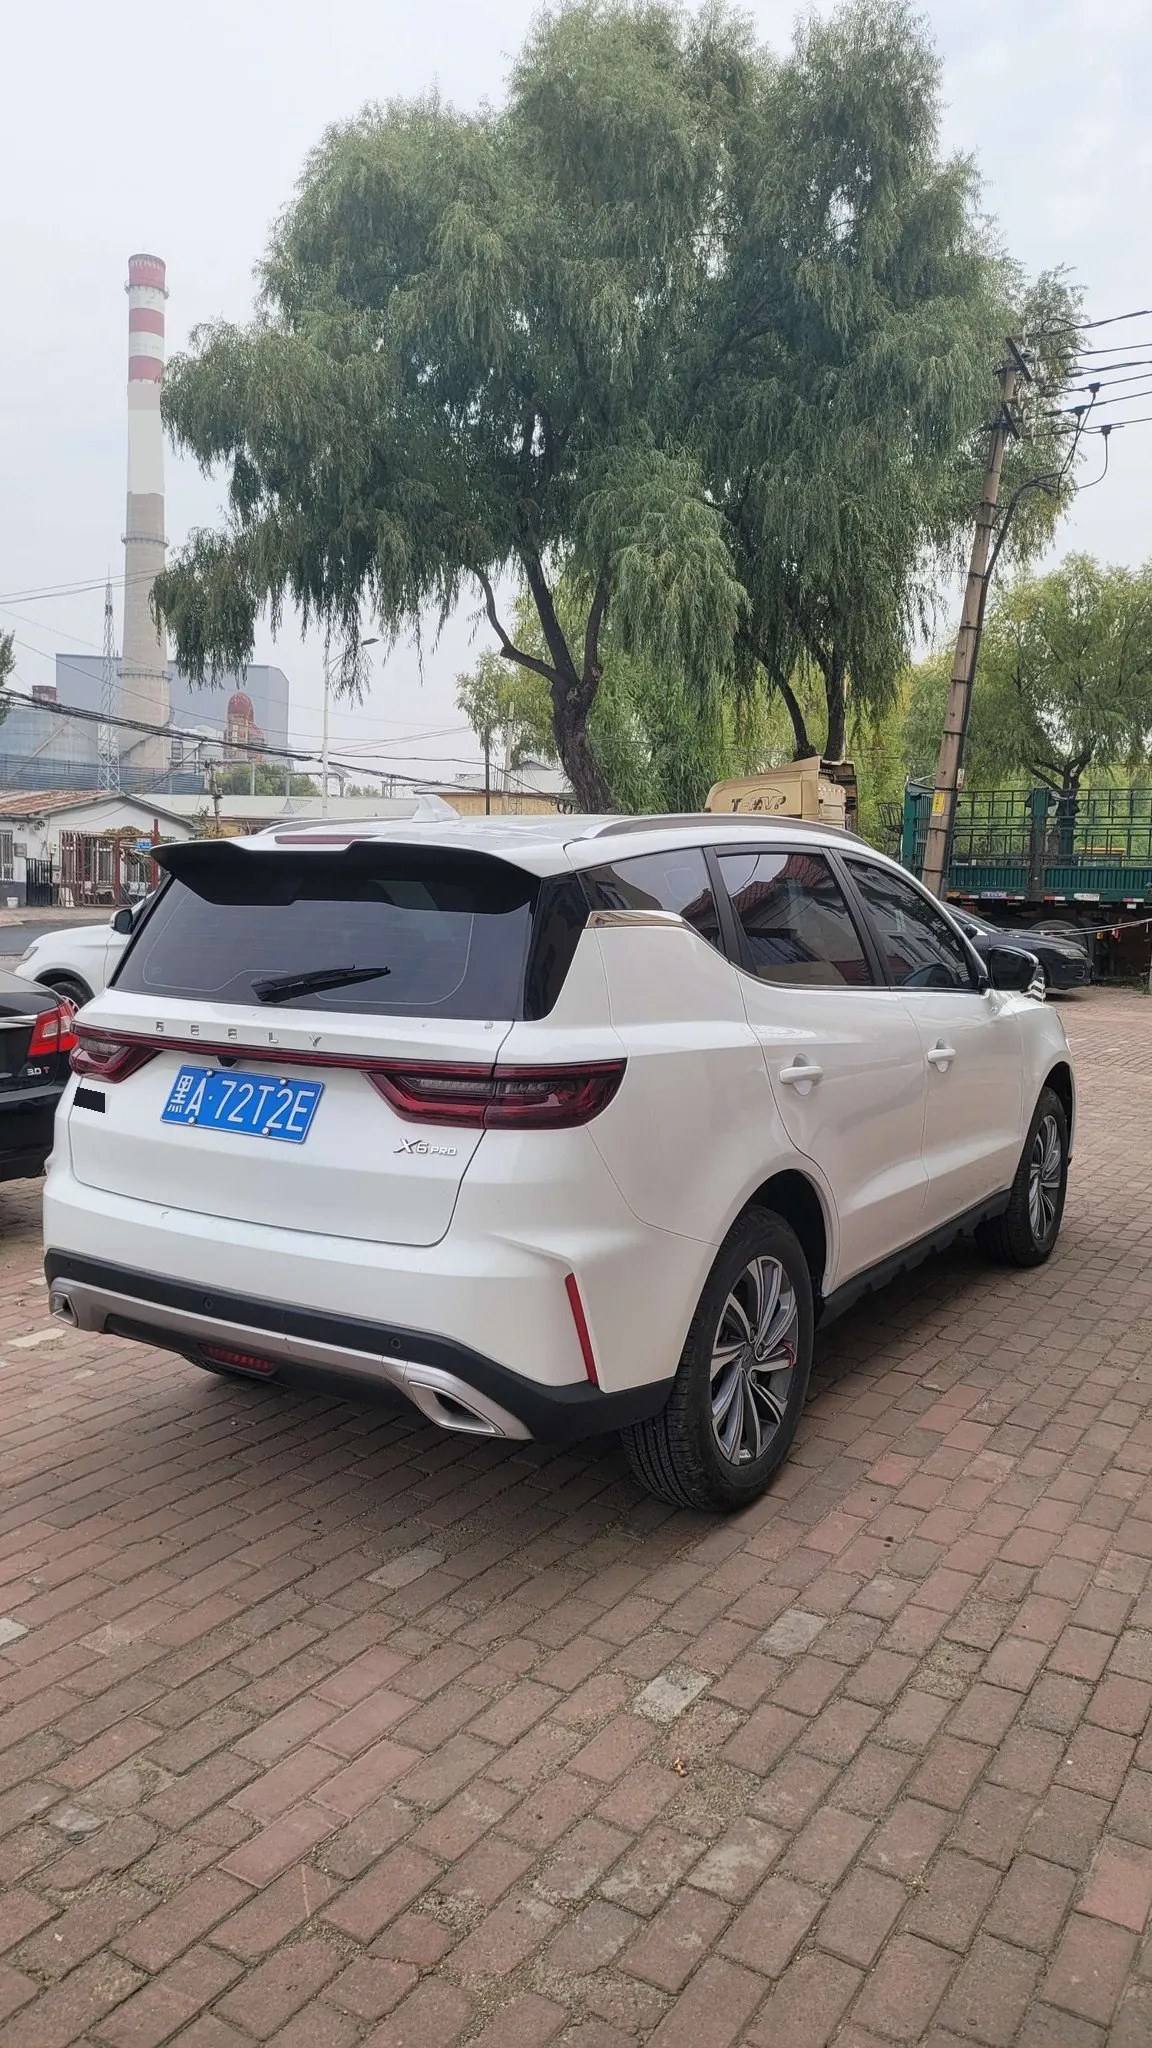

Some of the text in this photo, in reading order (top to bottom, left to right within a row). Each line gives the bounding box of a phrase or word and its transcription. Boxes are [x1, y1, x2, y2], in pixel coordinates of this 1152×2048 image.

[156, 1021, 322, 1047] GEELY
[167, 1075, 315, 1132] 黑A·72T2E
[393, 1138, 457, 1156] X6 PRO
